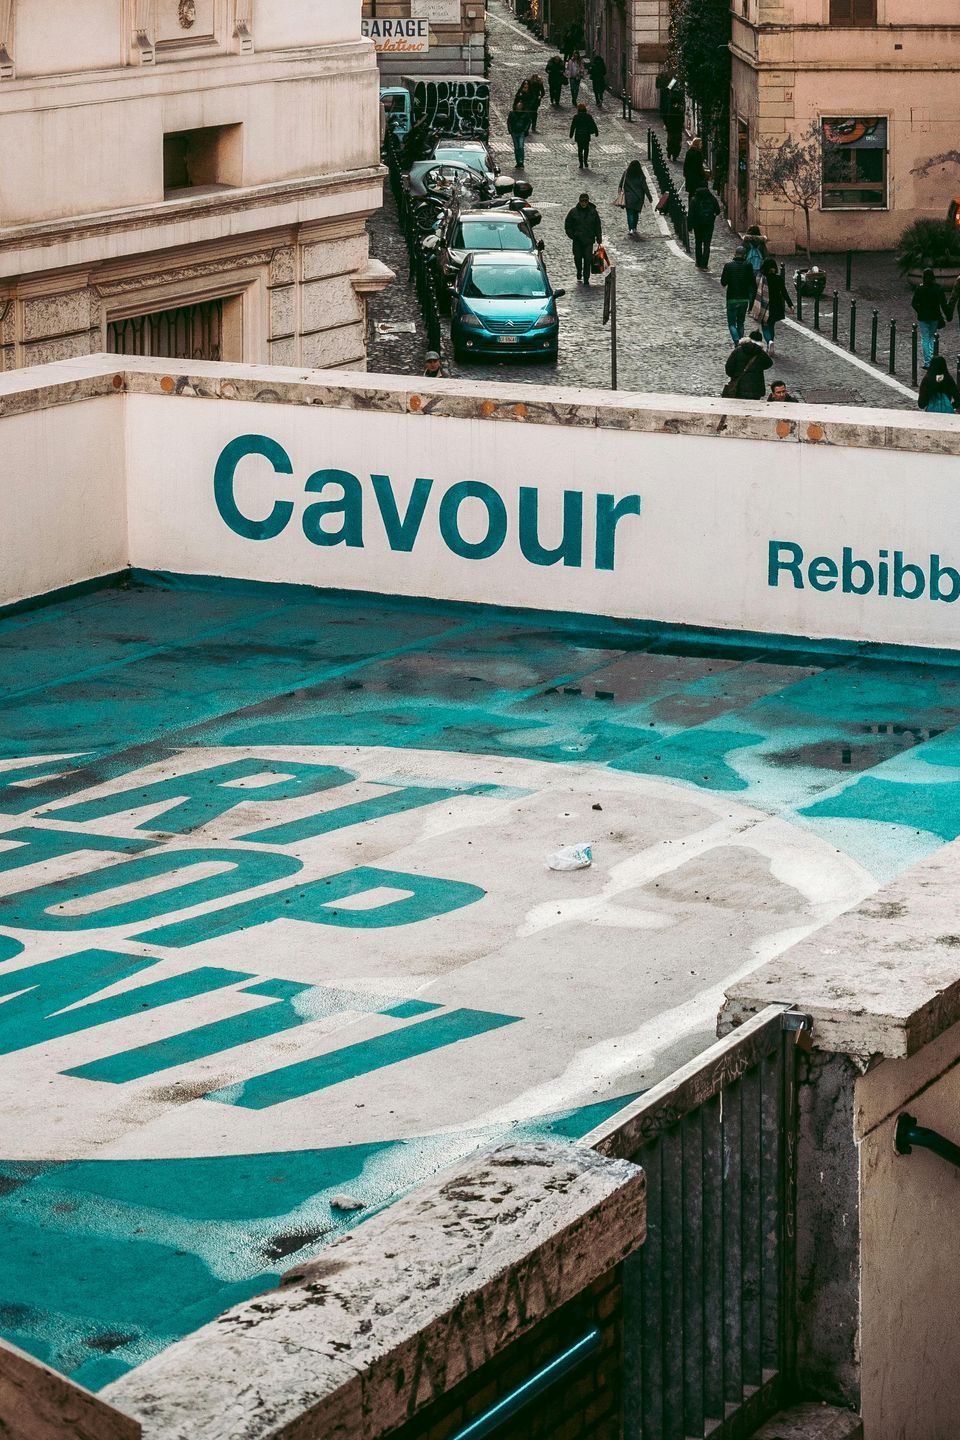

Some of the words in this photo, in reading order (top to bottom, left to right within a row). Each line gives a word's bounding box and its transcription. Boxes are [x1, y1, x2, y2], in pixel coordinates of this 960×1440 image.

[361, 20, 428, 37] GARAGE
[373, 38, 425, 52] alatino
[214, 435, 641, 571] Cavour
